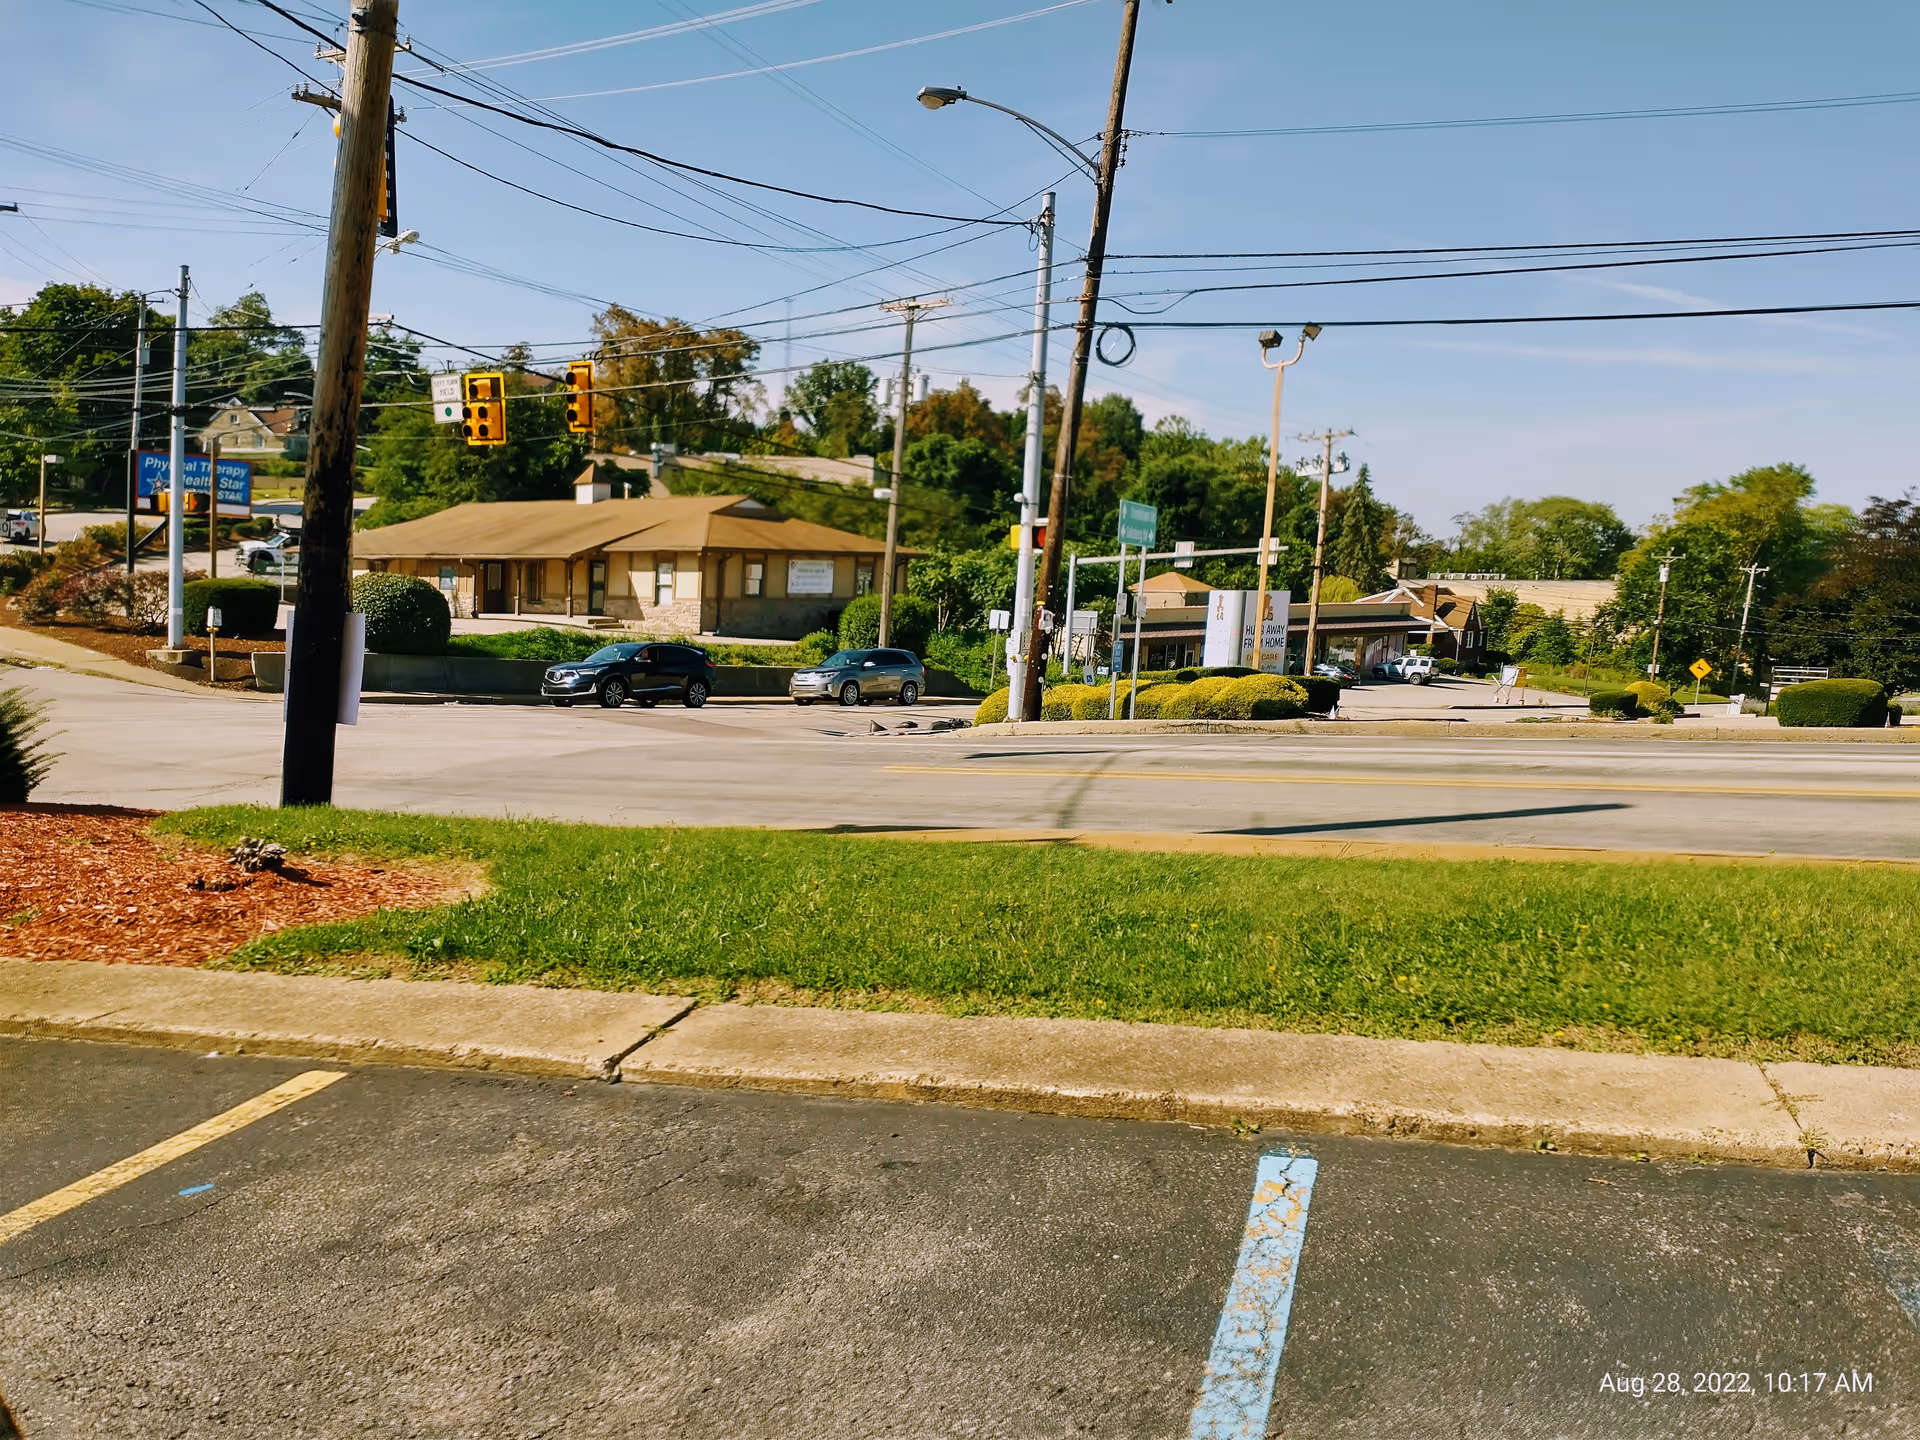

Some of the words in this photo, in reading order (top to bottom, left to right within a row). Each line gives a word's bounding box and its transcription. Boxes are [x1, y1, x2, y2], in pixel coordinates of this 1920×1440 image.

[145, 456, 198, 472] Phyal
[219, 477, 246, 490] Star
[1245, 625, 1265, 635] HUS
[1265, 624, 1285, 635] AWAY
[1243, 637, 1263, 648] FRM
[1265, 637, 1284, 648] HOME
[1261, 653, 1279, 661] CARE
